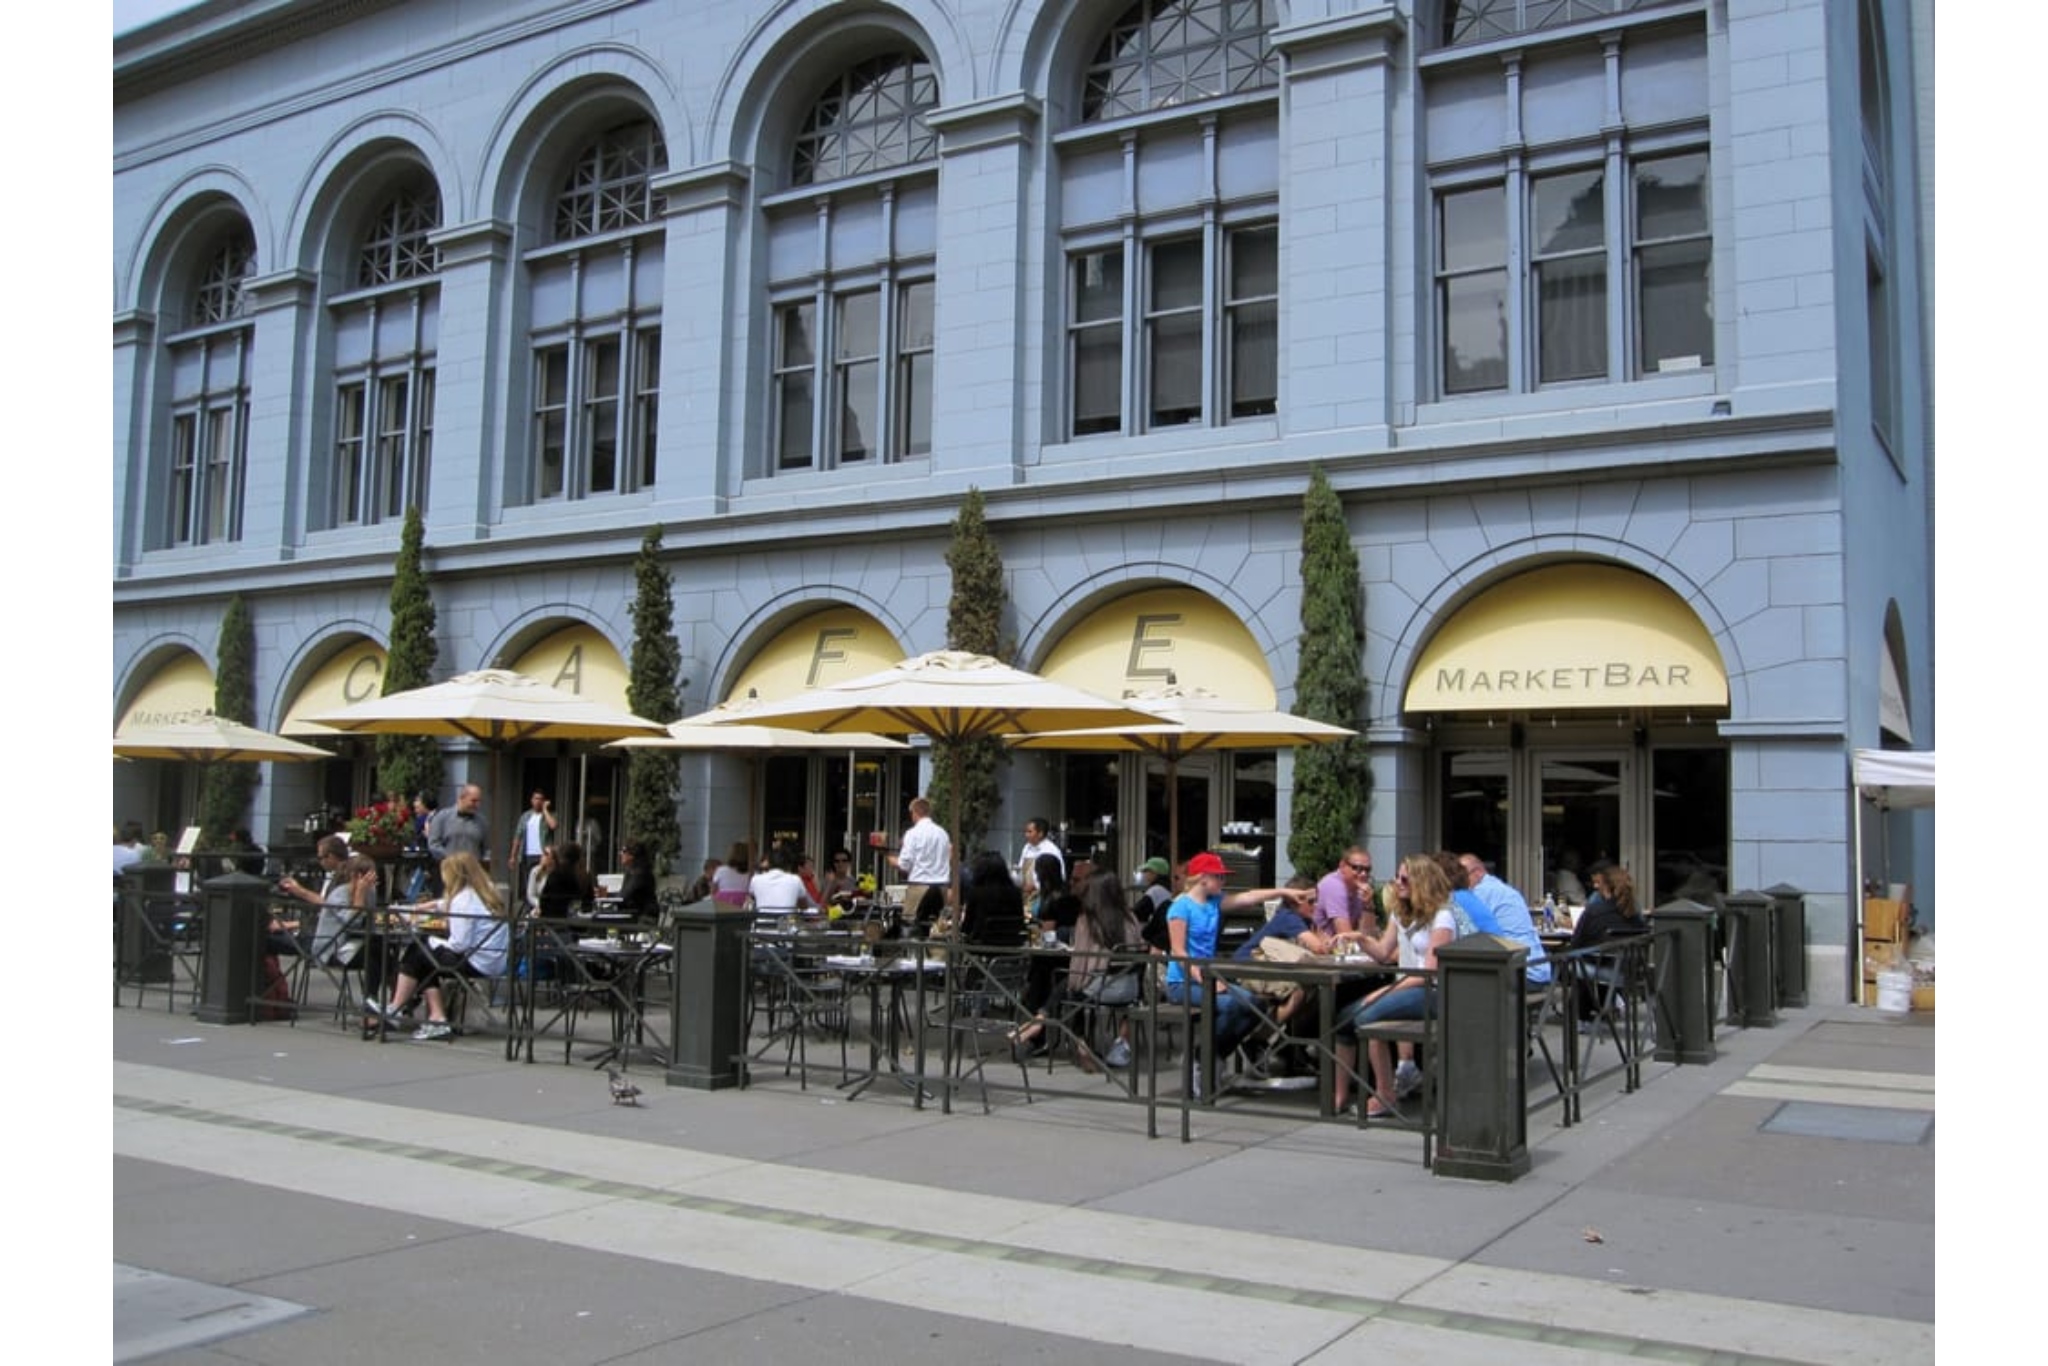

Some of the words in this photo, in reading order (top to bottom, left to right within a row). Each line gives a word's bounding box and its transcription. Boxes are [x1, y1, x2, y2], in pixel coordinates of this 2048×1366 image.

[552, 643, 583, 696] A
[805, 627, 857, 688] F
[1125, 613, 1184, 681] E
[344, 655, 382, 706] C
[1435, 662, 1692, 692] MARKETBAR
